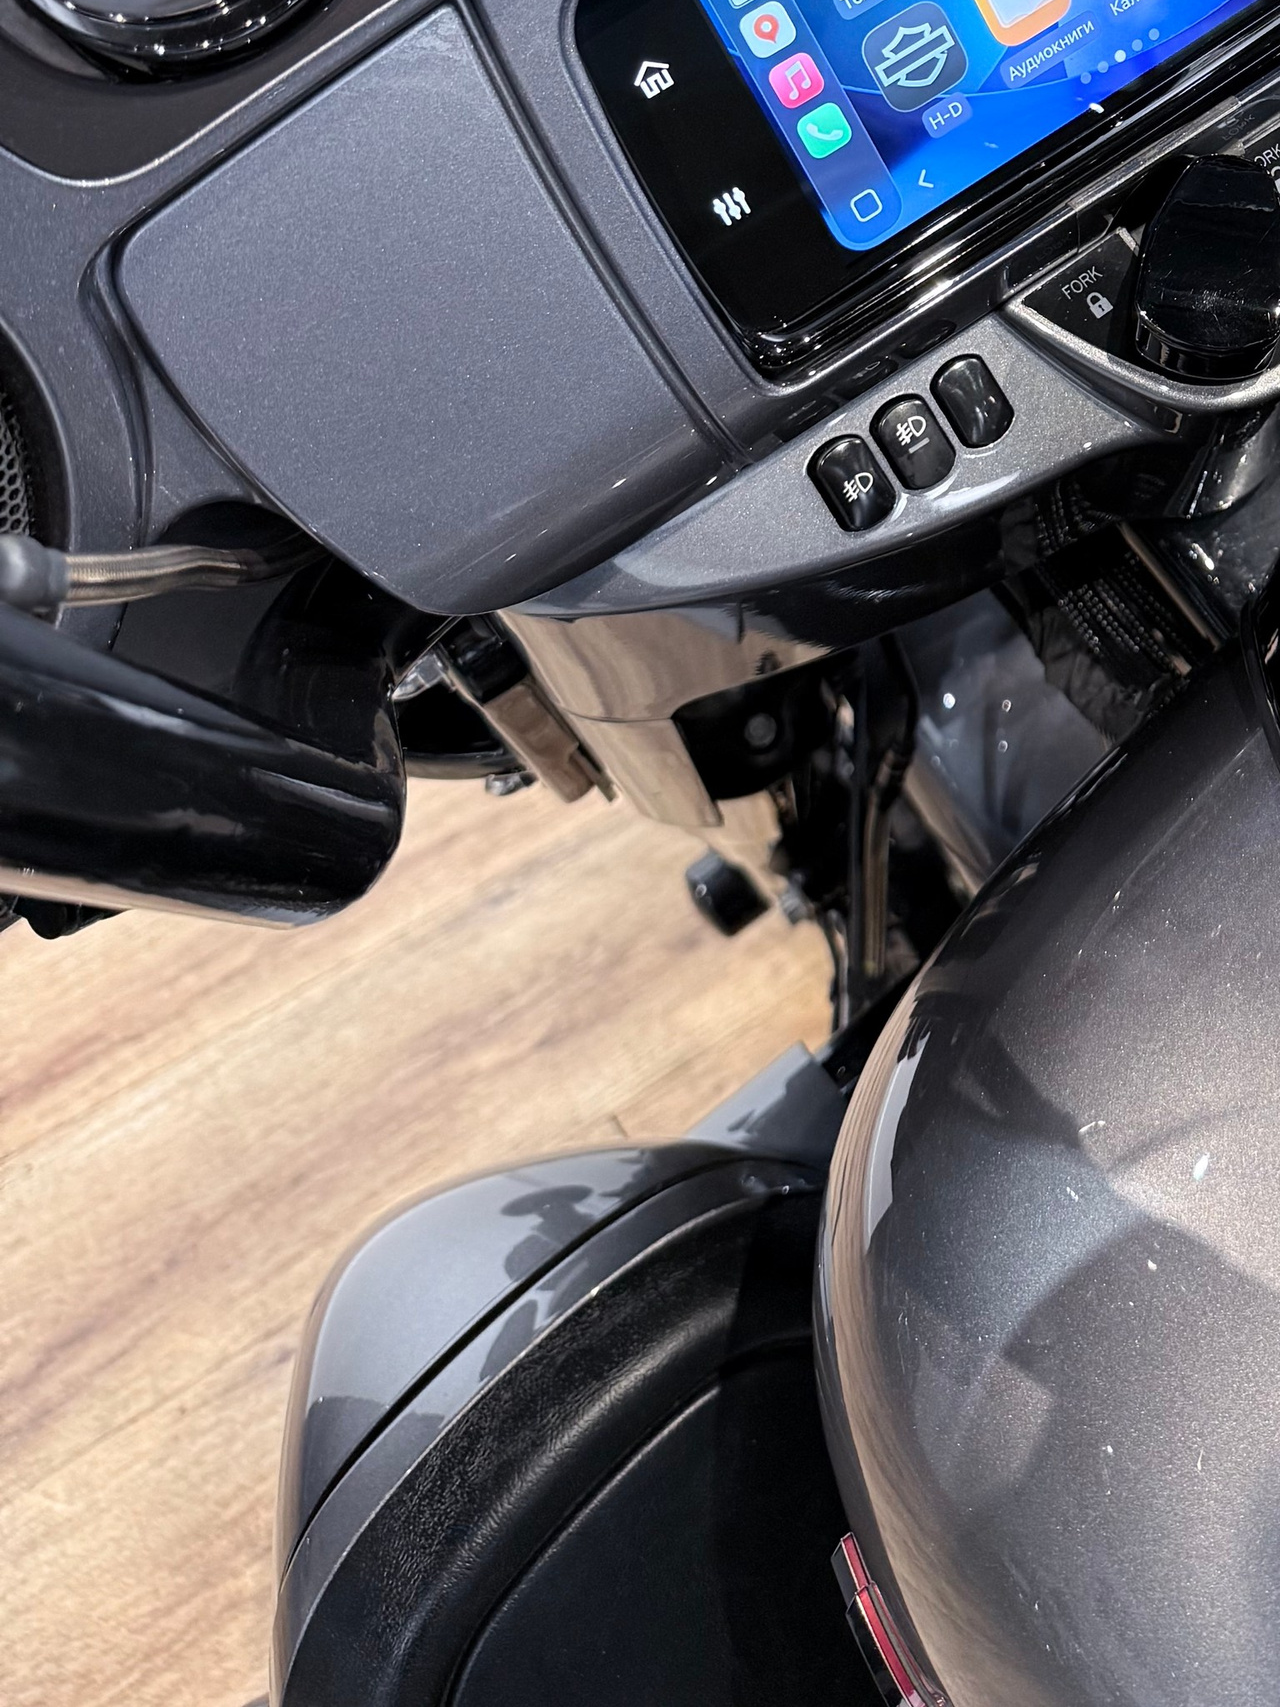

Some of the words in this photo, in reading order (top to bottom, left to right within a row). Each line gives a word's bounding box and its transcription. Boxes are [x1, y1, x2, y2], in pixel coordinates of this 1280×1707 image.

[1008, 20, 1095, 81] Аудиокниги
[928, 102, 963, 130] H-D
[1061, 266, 1103, 299] FORK
